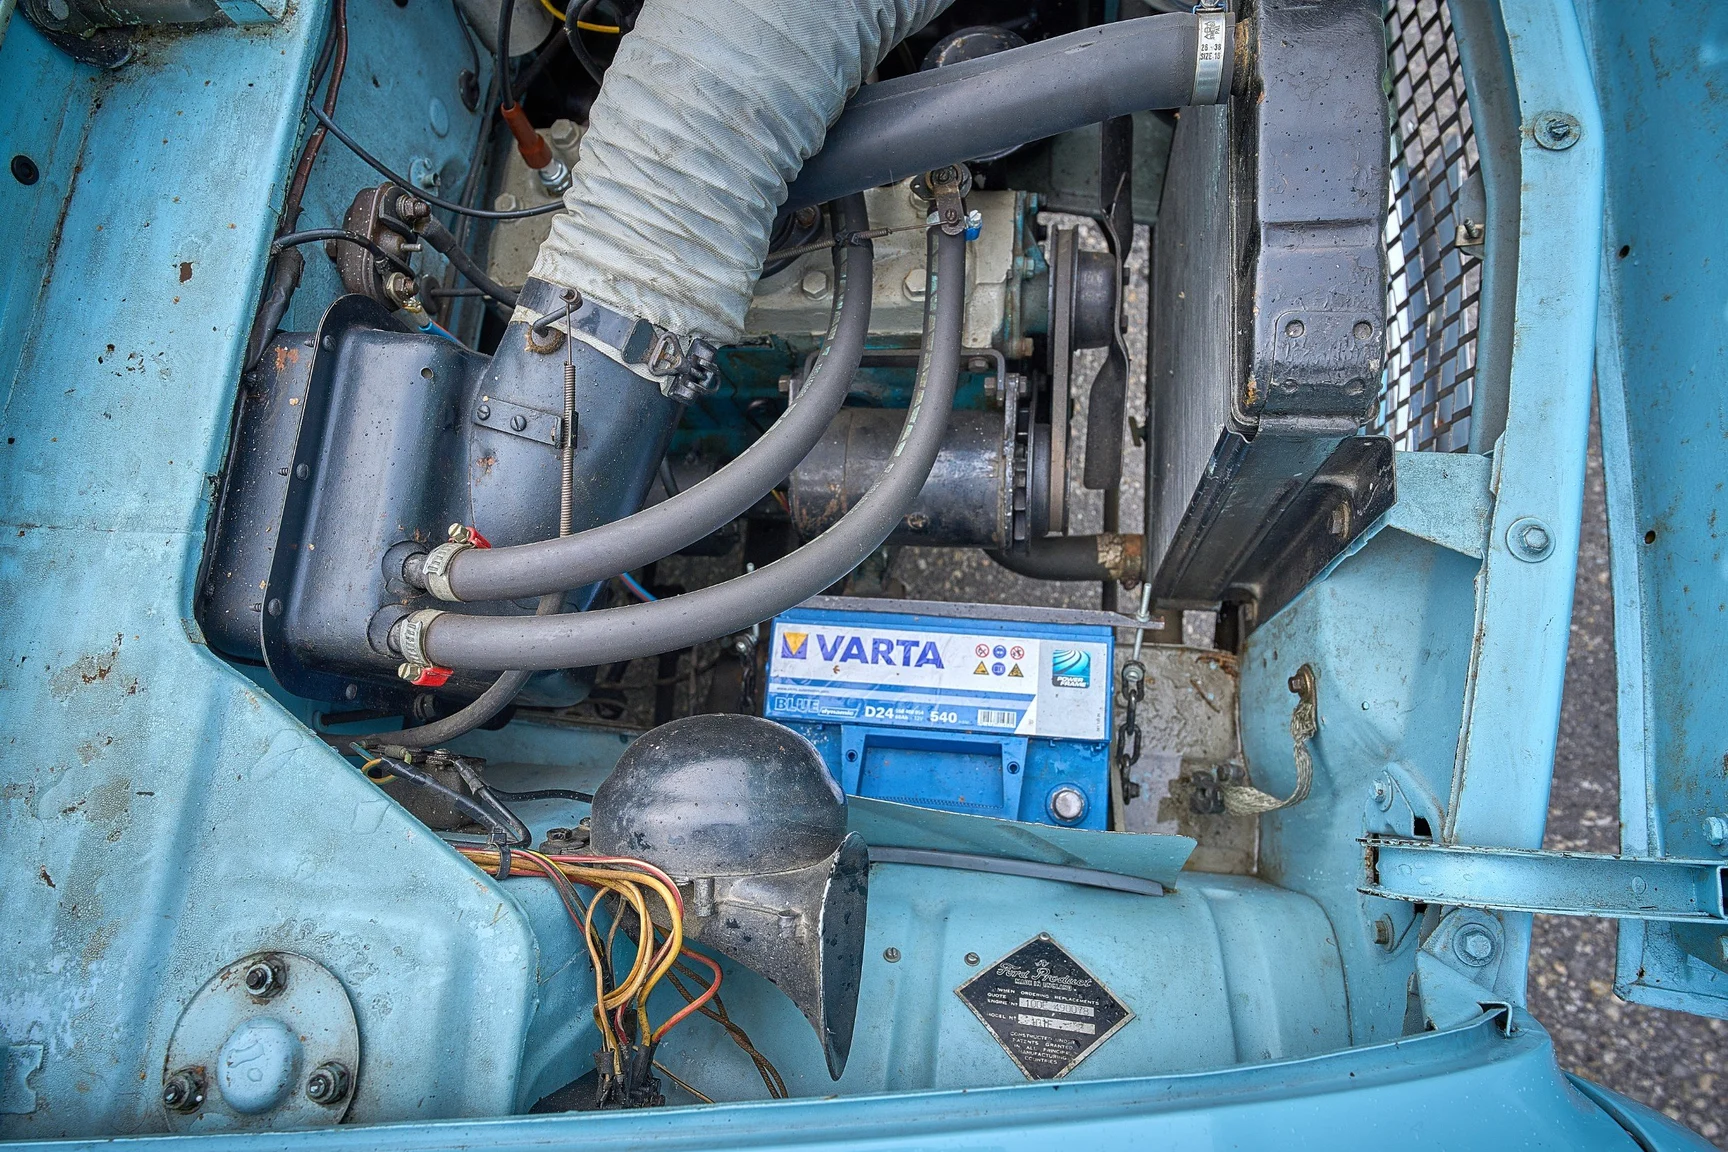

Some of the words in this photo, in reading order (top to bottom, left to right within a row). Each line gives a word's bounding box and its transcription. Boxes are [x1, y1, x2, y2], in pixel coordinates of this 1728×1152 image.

[1200, 52, 1212, 60] SIZE
[816, 634, 945, 669] VARTA
[774, 696, 820, 713] BLUE
[821, 708, 855, 716] dynamic
[865, 706, 894, 719] D24
[930, 711, 957, 723] 540
[997, 962, 1030, 979] Ford
[1031, 967, 1092, 987] Product
[1020, 990, 1050, 999] ORDERING
[1054, 995, 1100, 1006] REPLACEMENTS
[1010, 1031, 1052, 1041] CONSTRUCTED
[1024, 1056, 1058, 1064] COUNTRIES
[1043, 1047, 1074, 1057] PRINCIPA
